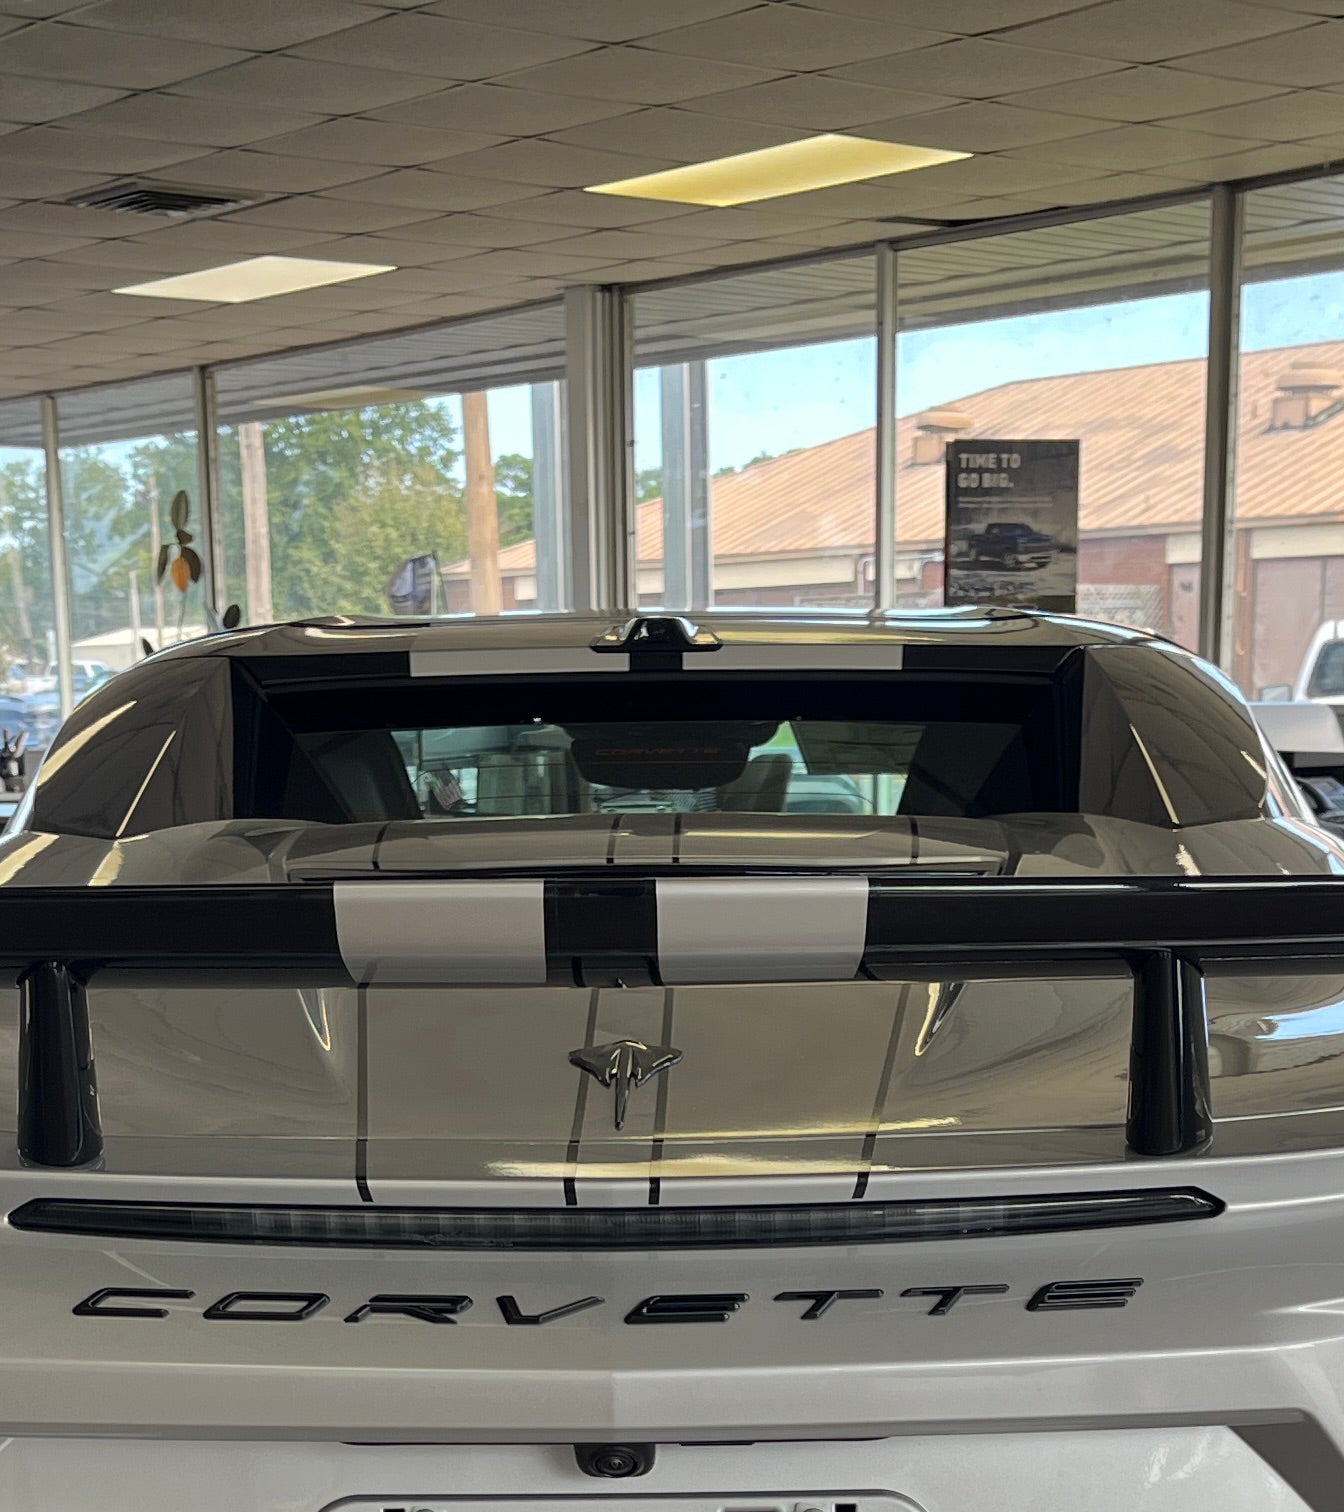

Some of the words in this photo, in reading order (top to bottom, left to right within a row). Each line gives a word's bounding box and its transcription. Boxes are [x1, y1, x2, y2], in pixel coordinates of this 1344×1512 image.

[958, 453, 997, 469] TIME
[999, 453, 1021, 469] TO
[958, 473, 980, 488] GO
[72, 1276, 1144, 1325] CORVETTE
